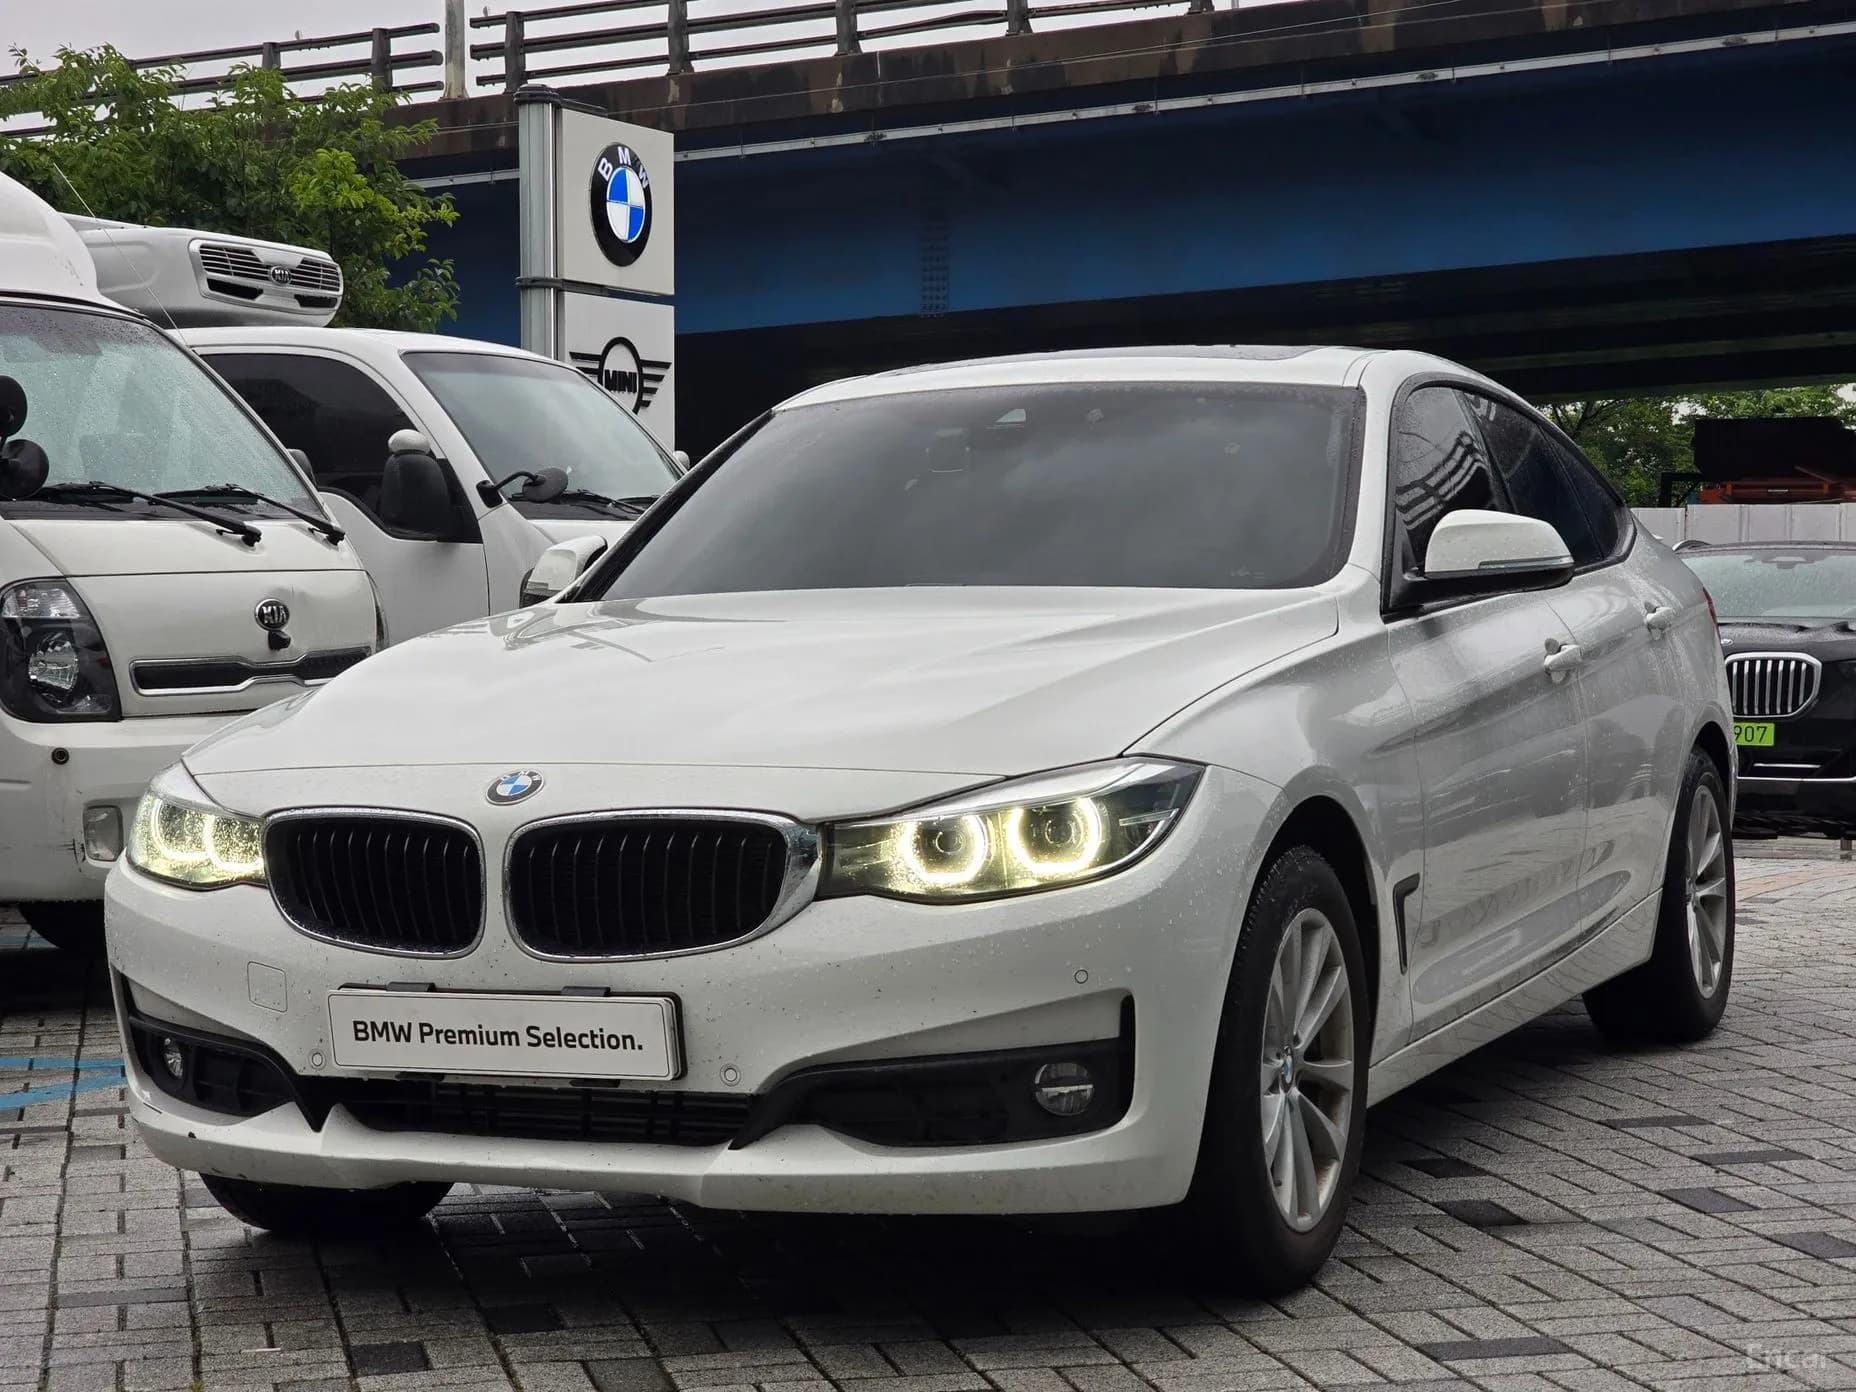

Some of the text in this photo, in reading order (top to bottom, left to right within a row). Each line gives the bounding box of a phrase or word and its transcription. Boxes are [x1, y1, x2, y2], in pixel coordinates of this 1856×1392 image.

[598, 146, 650, 190] BMW
[604, 369, 637, 393] MINI
[262, 605, 287, 624] KIA
[352, 1020, 643, 1051] BMW Premium Selection.
